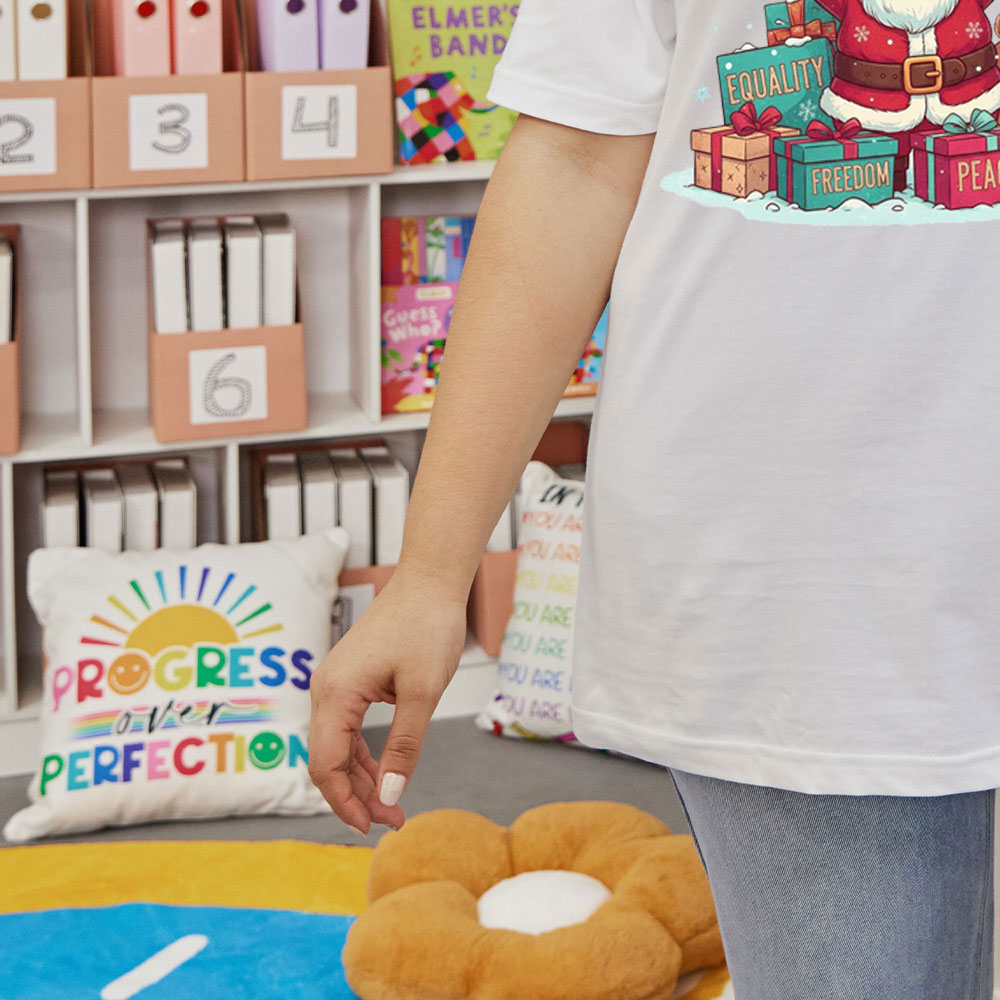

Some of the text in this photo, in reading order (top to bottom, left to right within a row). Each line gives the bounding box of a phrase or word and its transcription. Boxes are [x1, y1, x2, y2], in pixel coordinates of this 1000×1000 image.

[430, 33, 508, 59] BAND
[725, 56, 826, 106] EQUALITY
[0, 113, 35, 164] 2
[152, 102, 193, 155] 3
[290, 96, 340, 148] 4
[811, 160, 891, 196] FREEDOM
[383, 305, 438, 328] Guess
[203, 353, 253, 418] 6
[52, 645, 315, 714] PROGRESS
[115, 699, 240, 735] over
